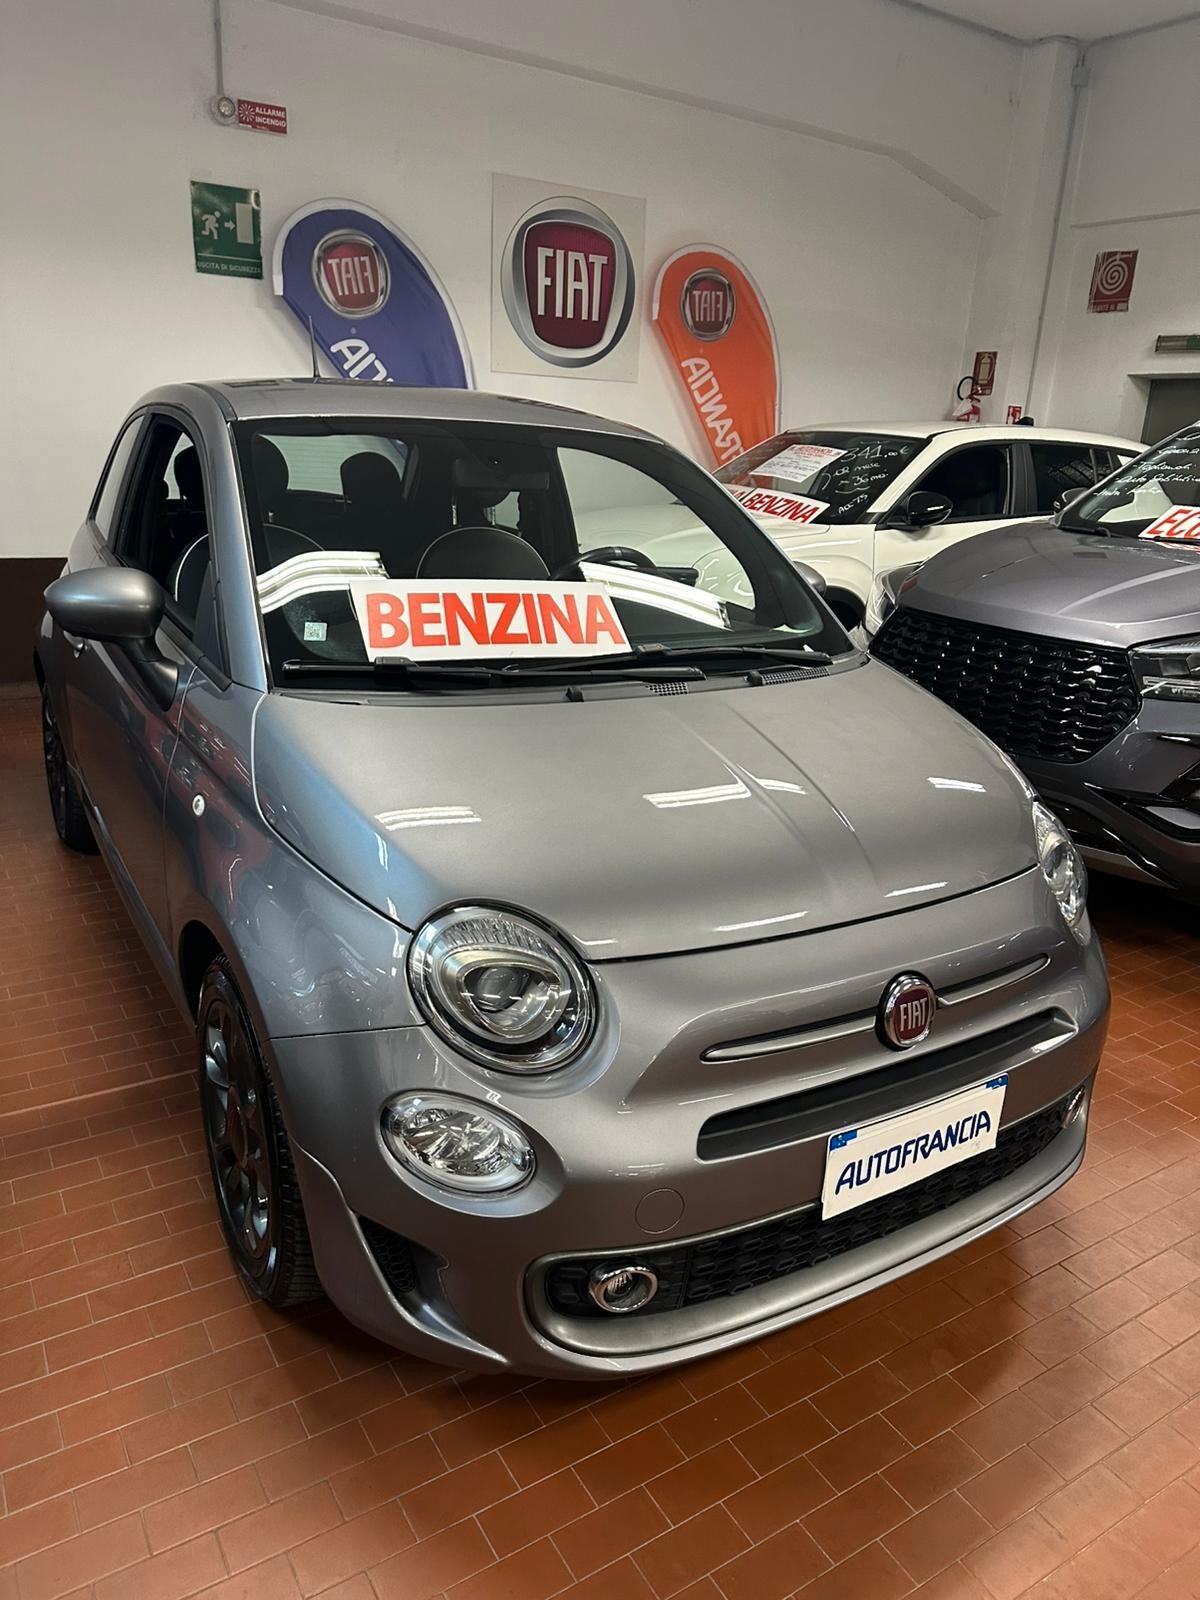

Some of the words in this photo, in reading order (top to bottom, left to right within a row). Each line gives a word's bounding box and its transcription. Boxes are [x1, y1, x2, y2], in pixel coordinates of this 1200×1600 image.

[255, 107, 285, 118] ALLARME
[255, 116, 286, 127] INCENDIO
[537, 246, 608, 322] FIAT
[742, 493, 820, 523] BENZINA
[365, 592, 626, 648] BENZINA
[900, 997, 928, 1032] FIAT
[835, 1110, 991, 1195] AUTOFRANCIA
